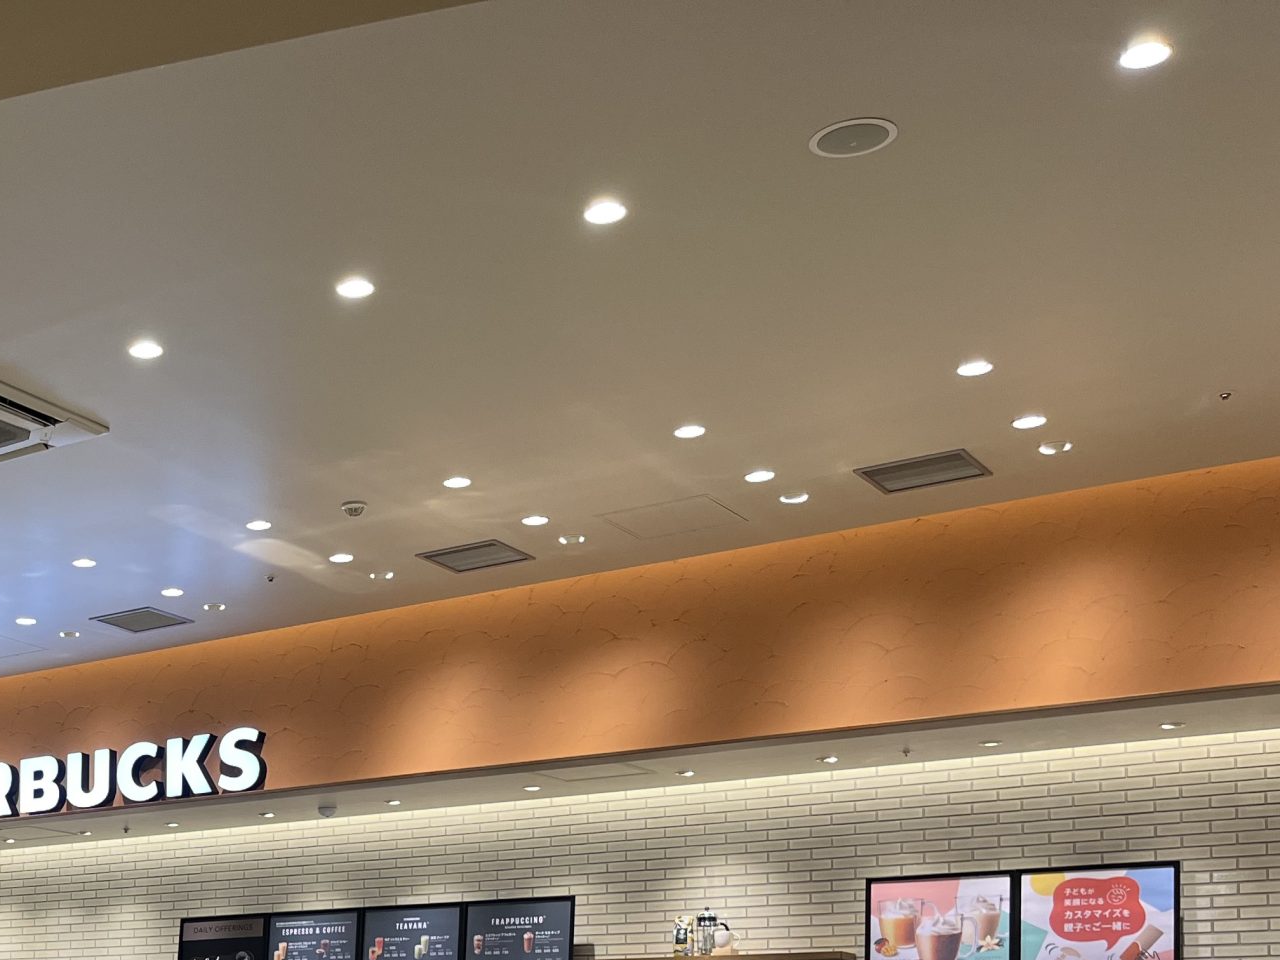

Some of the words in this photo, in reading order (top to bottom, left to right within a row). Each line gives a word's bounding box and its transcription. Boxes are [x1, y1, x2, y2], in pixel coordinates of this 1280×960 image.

[1064, 888, 1095, 896] 子どもが
[1063, 898, 1104, 906] 笑顔になる
[1064, 908, 1131, 919] カスタマイズを
[396, 921, 428, 930] TEAVANA
[491, 915, 544, 926] FRAPPUCCINO
[193, 925, 214, 934] DAILY
[215, 923, 253, 933] OFFERINGS
[282, 927, 313, 936] ESPRESSO
[322, 926, 345, 934] COFFEE
[1063, 921, 1131, 932] 親子でご一緒に
